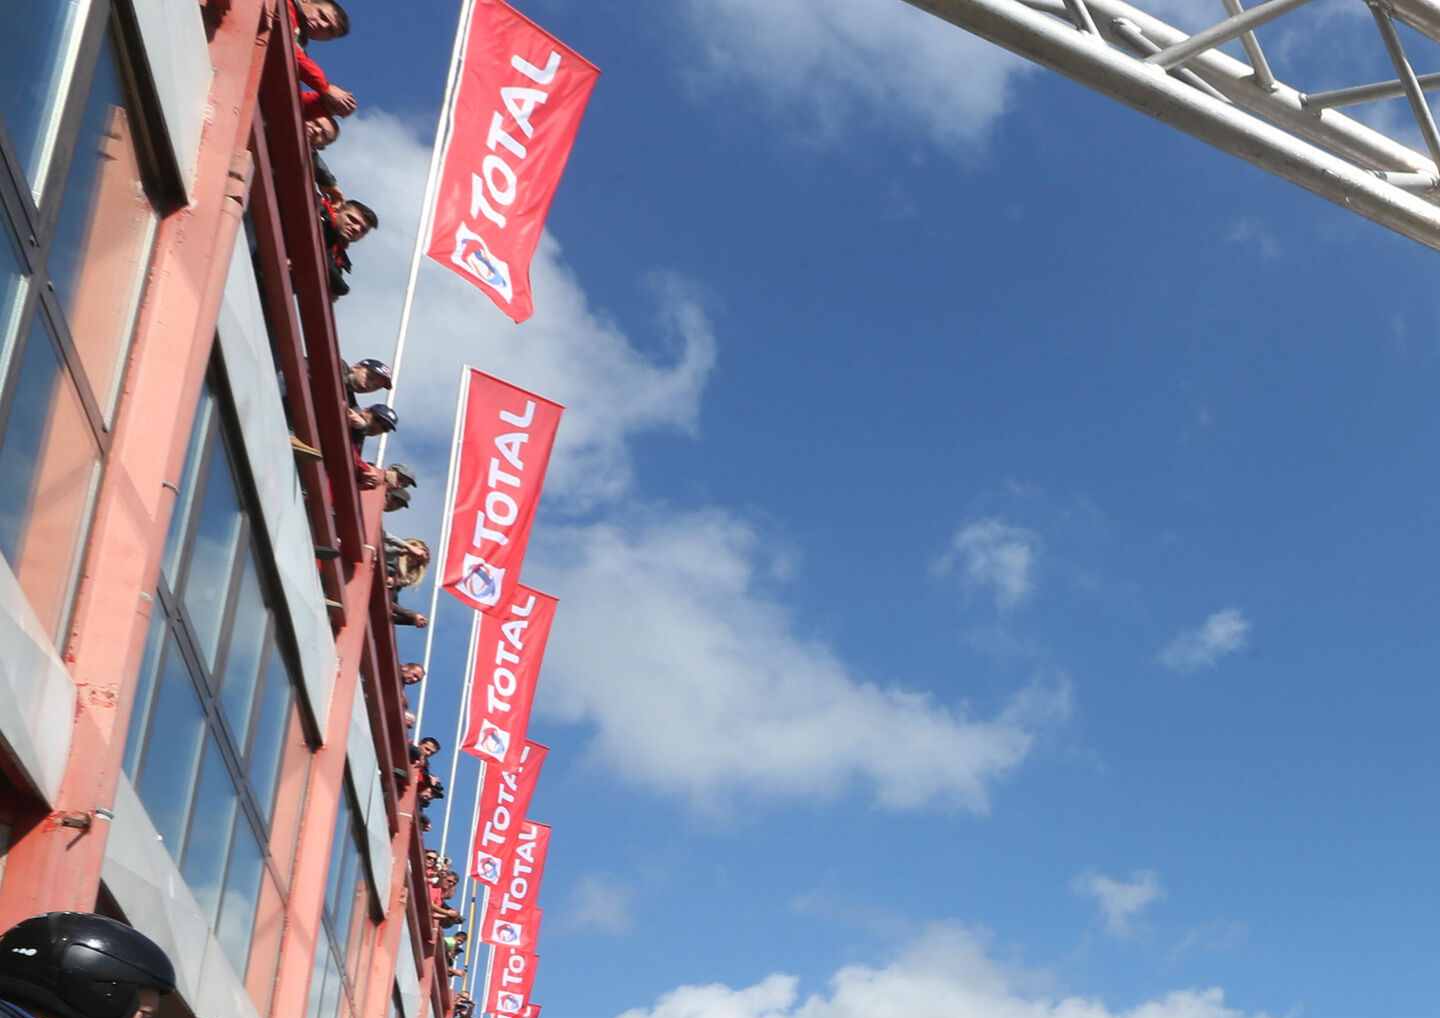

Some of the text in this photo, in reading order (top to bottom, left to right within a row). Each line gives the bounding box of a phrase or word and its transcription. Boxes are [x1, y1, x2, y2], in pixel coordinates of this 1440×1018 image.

[471, 50, 562, 229] TOTAL
[472, 400, 536, 548] TOTAL
[487, 595, 536, 714] TOTAL
[500, 825, 538, 915] TOTAL
